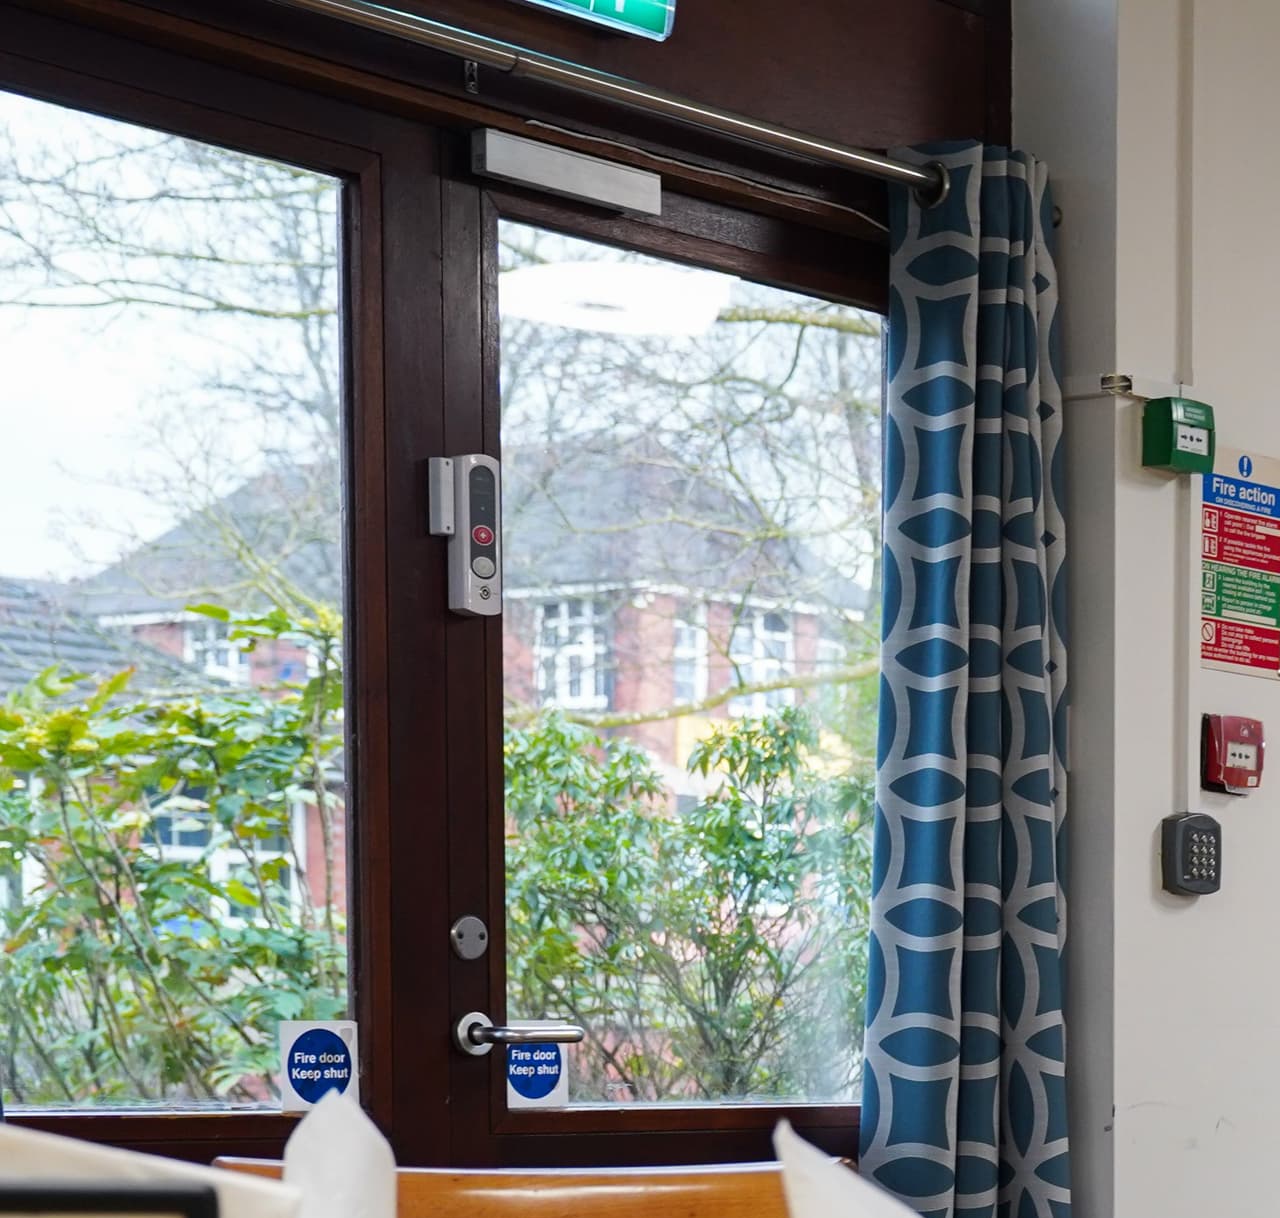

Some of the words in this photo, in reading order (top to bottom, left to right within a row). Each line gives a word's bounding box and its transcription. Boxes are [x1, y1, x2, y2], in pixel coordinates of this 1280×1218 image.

[1212, 477, 1236, 497] Fire
[1239, 487, 1275, 506] action
[294, 1052, 317, 1064] Fire
[319, 1052, 346, 1063] door
[511, 1049, 531, 1060] Fire
[533, 1049, 557, 1060] door
[292, 1067, 321, 1082] Keep
[323, 1067, 348, 1078] shut
[509, 1064, 535, 1077] Keep
[537, 1064, 559, 1075] shut
